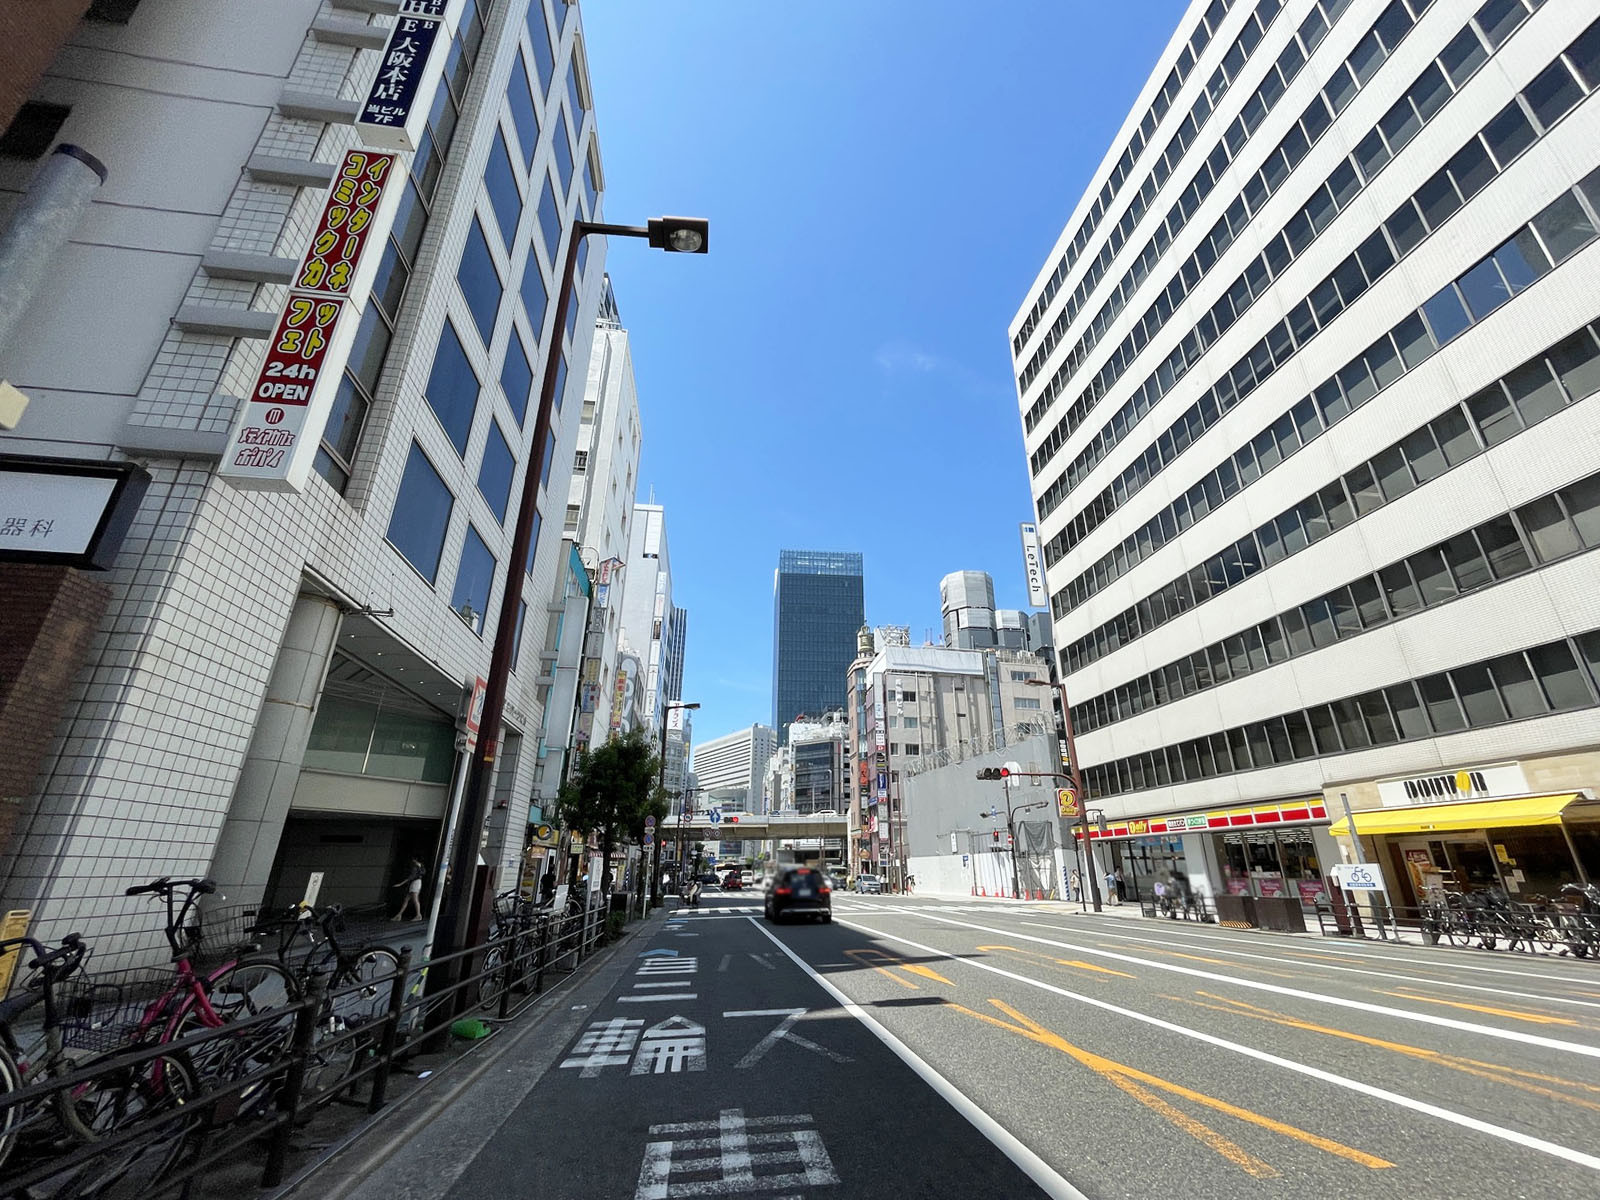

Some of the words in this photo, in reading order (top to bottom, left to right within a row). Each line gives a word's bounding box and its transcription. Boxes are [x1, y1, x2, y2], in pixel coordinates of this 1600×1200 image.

[373, 37, 420, 101] 大阪本店
[367, 104, 405, 116] 当ビル
[374, 114, 394, 124] 7F
[265, 361, 316, 380] 24h
[258, 382, 309, 400] OPEN
[234, 448, 285, 468] ポパイ
[1026, 545, 1041, 592] LeTech
[1403, 770, 1487, 799] DOUTOR
